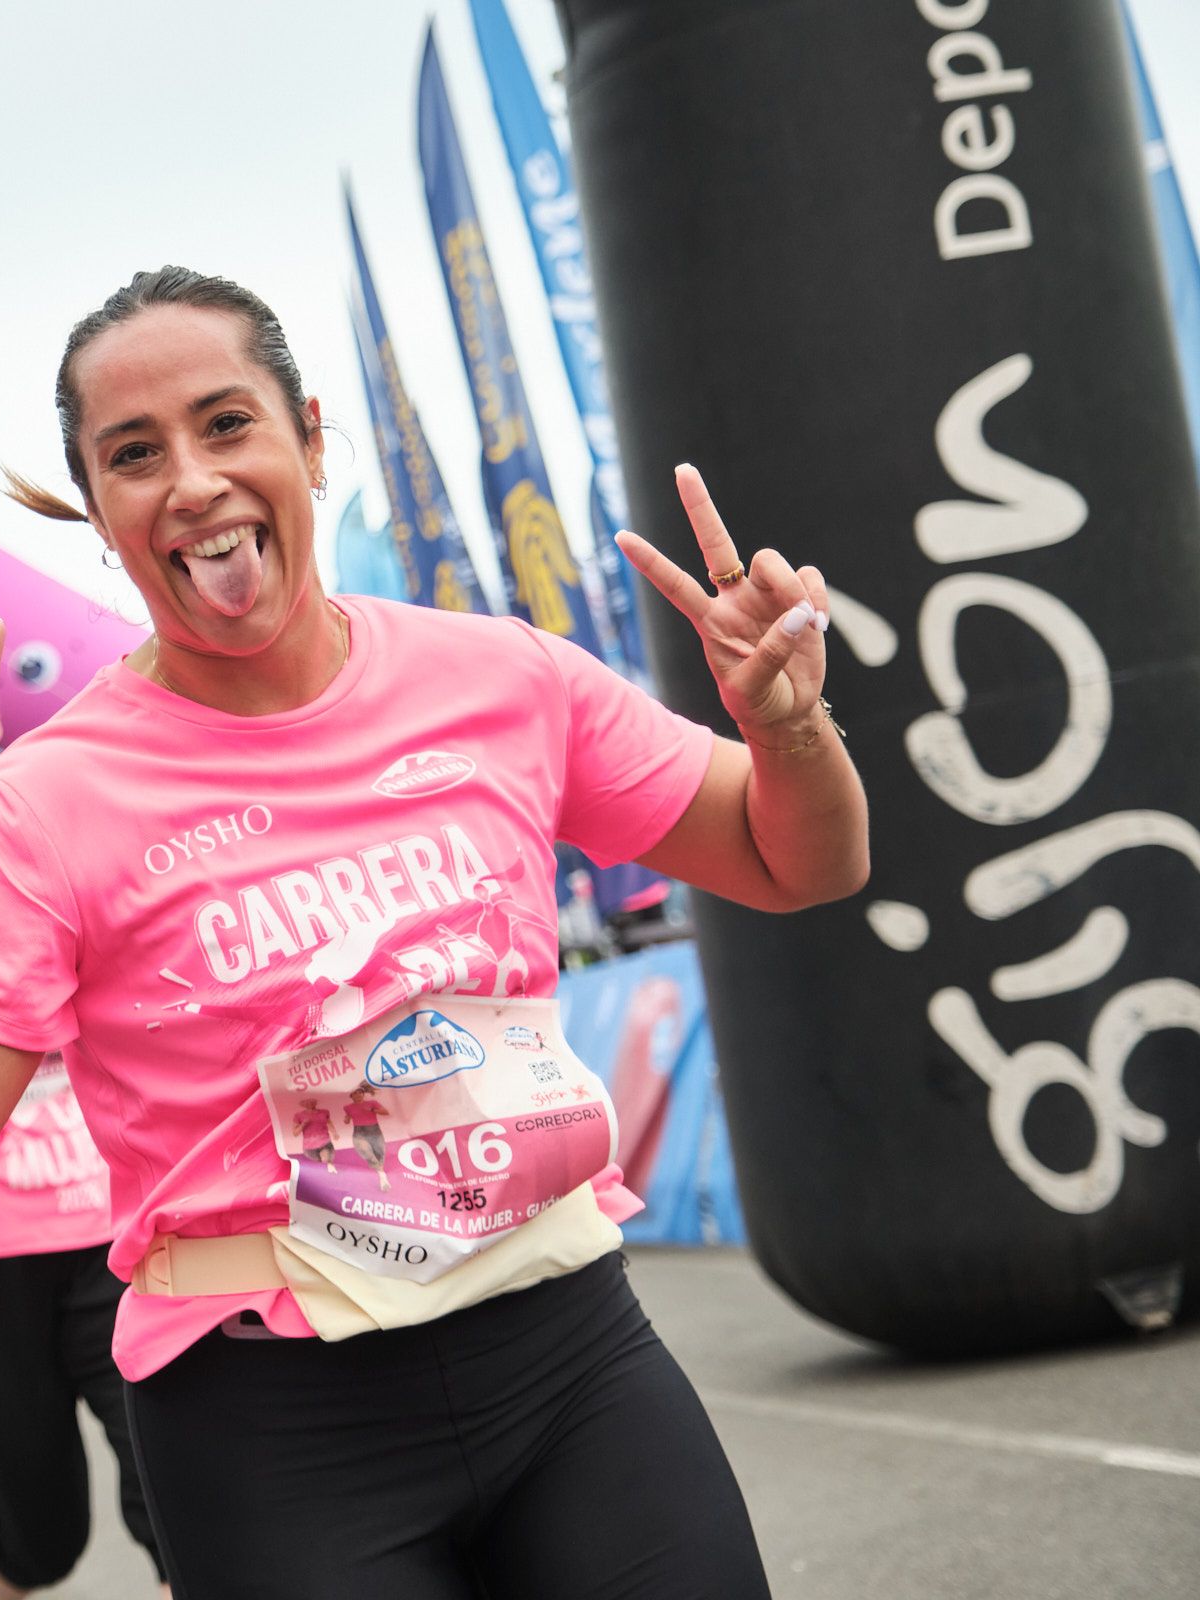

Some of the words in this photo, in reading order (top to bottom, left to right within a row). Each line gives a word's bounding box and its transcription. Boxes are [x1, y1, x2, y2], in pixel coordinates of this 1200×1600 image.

[143, 803, 273, 876] OYSHO
[193, 823, 501, 984] CARRERA
[287, 1062, 302, 1077] TU
[303, 1044, 349, 1070] DORSAL
[292, 1055, 357, 1093] SUMA
[514, 1107, 603, 1133] CORREDORA
[397, 1122, 513, 1179] 016
[341, 1195, 415, 1225] CARRERA
[419, 1212, 440, 1229] DE
[444, 1218, 464, 1235] LA
[467, 1211, 514, 1235] MUJER
[526, 1194, 565, 1219] GIJÓ
[437, 1188, 488, 1212] 1255
[326, 1221, 429, 1266] OYSHO
